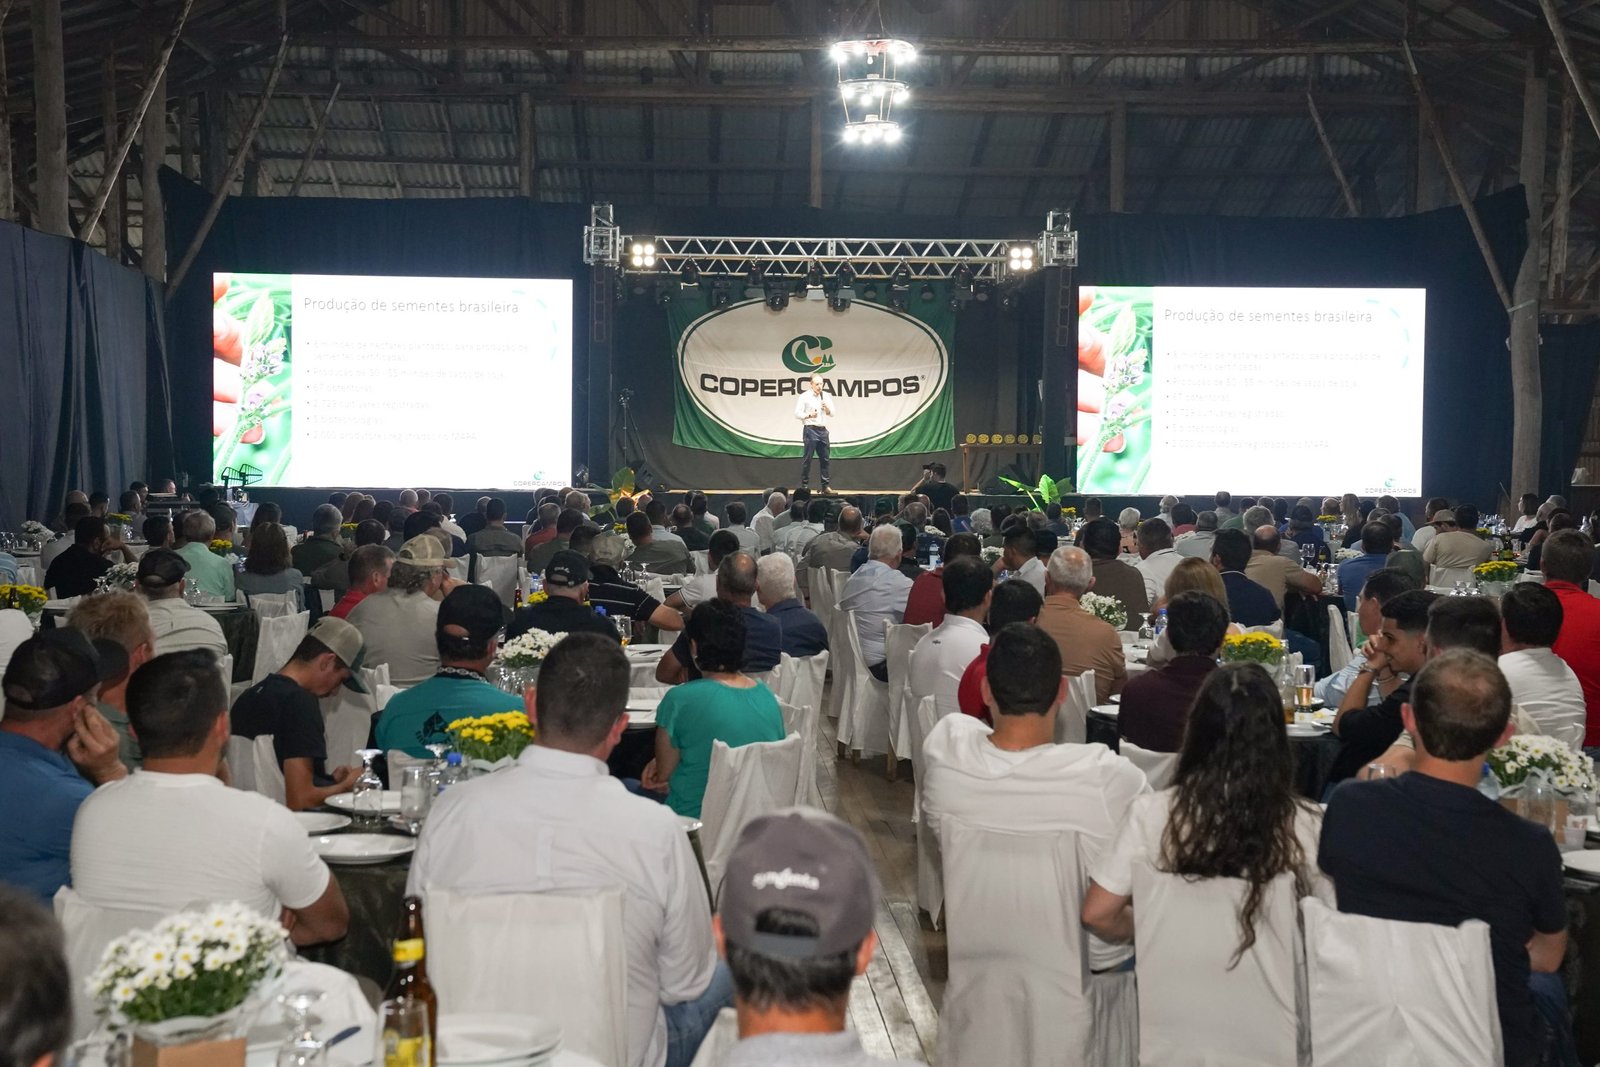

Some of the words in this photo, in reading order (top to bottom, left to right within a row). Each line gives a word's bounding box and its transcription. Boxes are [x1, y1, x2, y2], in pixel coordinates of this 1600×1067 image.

[304, 297, 367, 314] Produção
[371, 298, 387, 311] de
[392, 300, 455, 312] sementes
[459, 298, 519, 313] brasileira
[1164, 308, 1225, 324] Produção
[1228, 309, 1245, 322] de
[1249, 311, 1310, 323] sementes
[1314, 309, 1373, 324] brasileira
